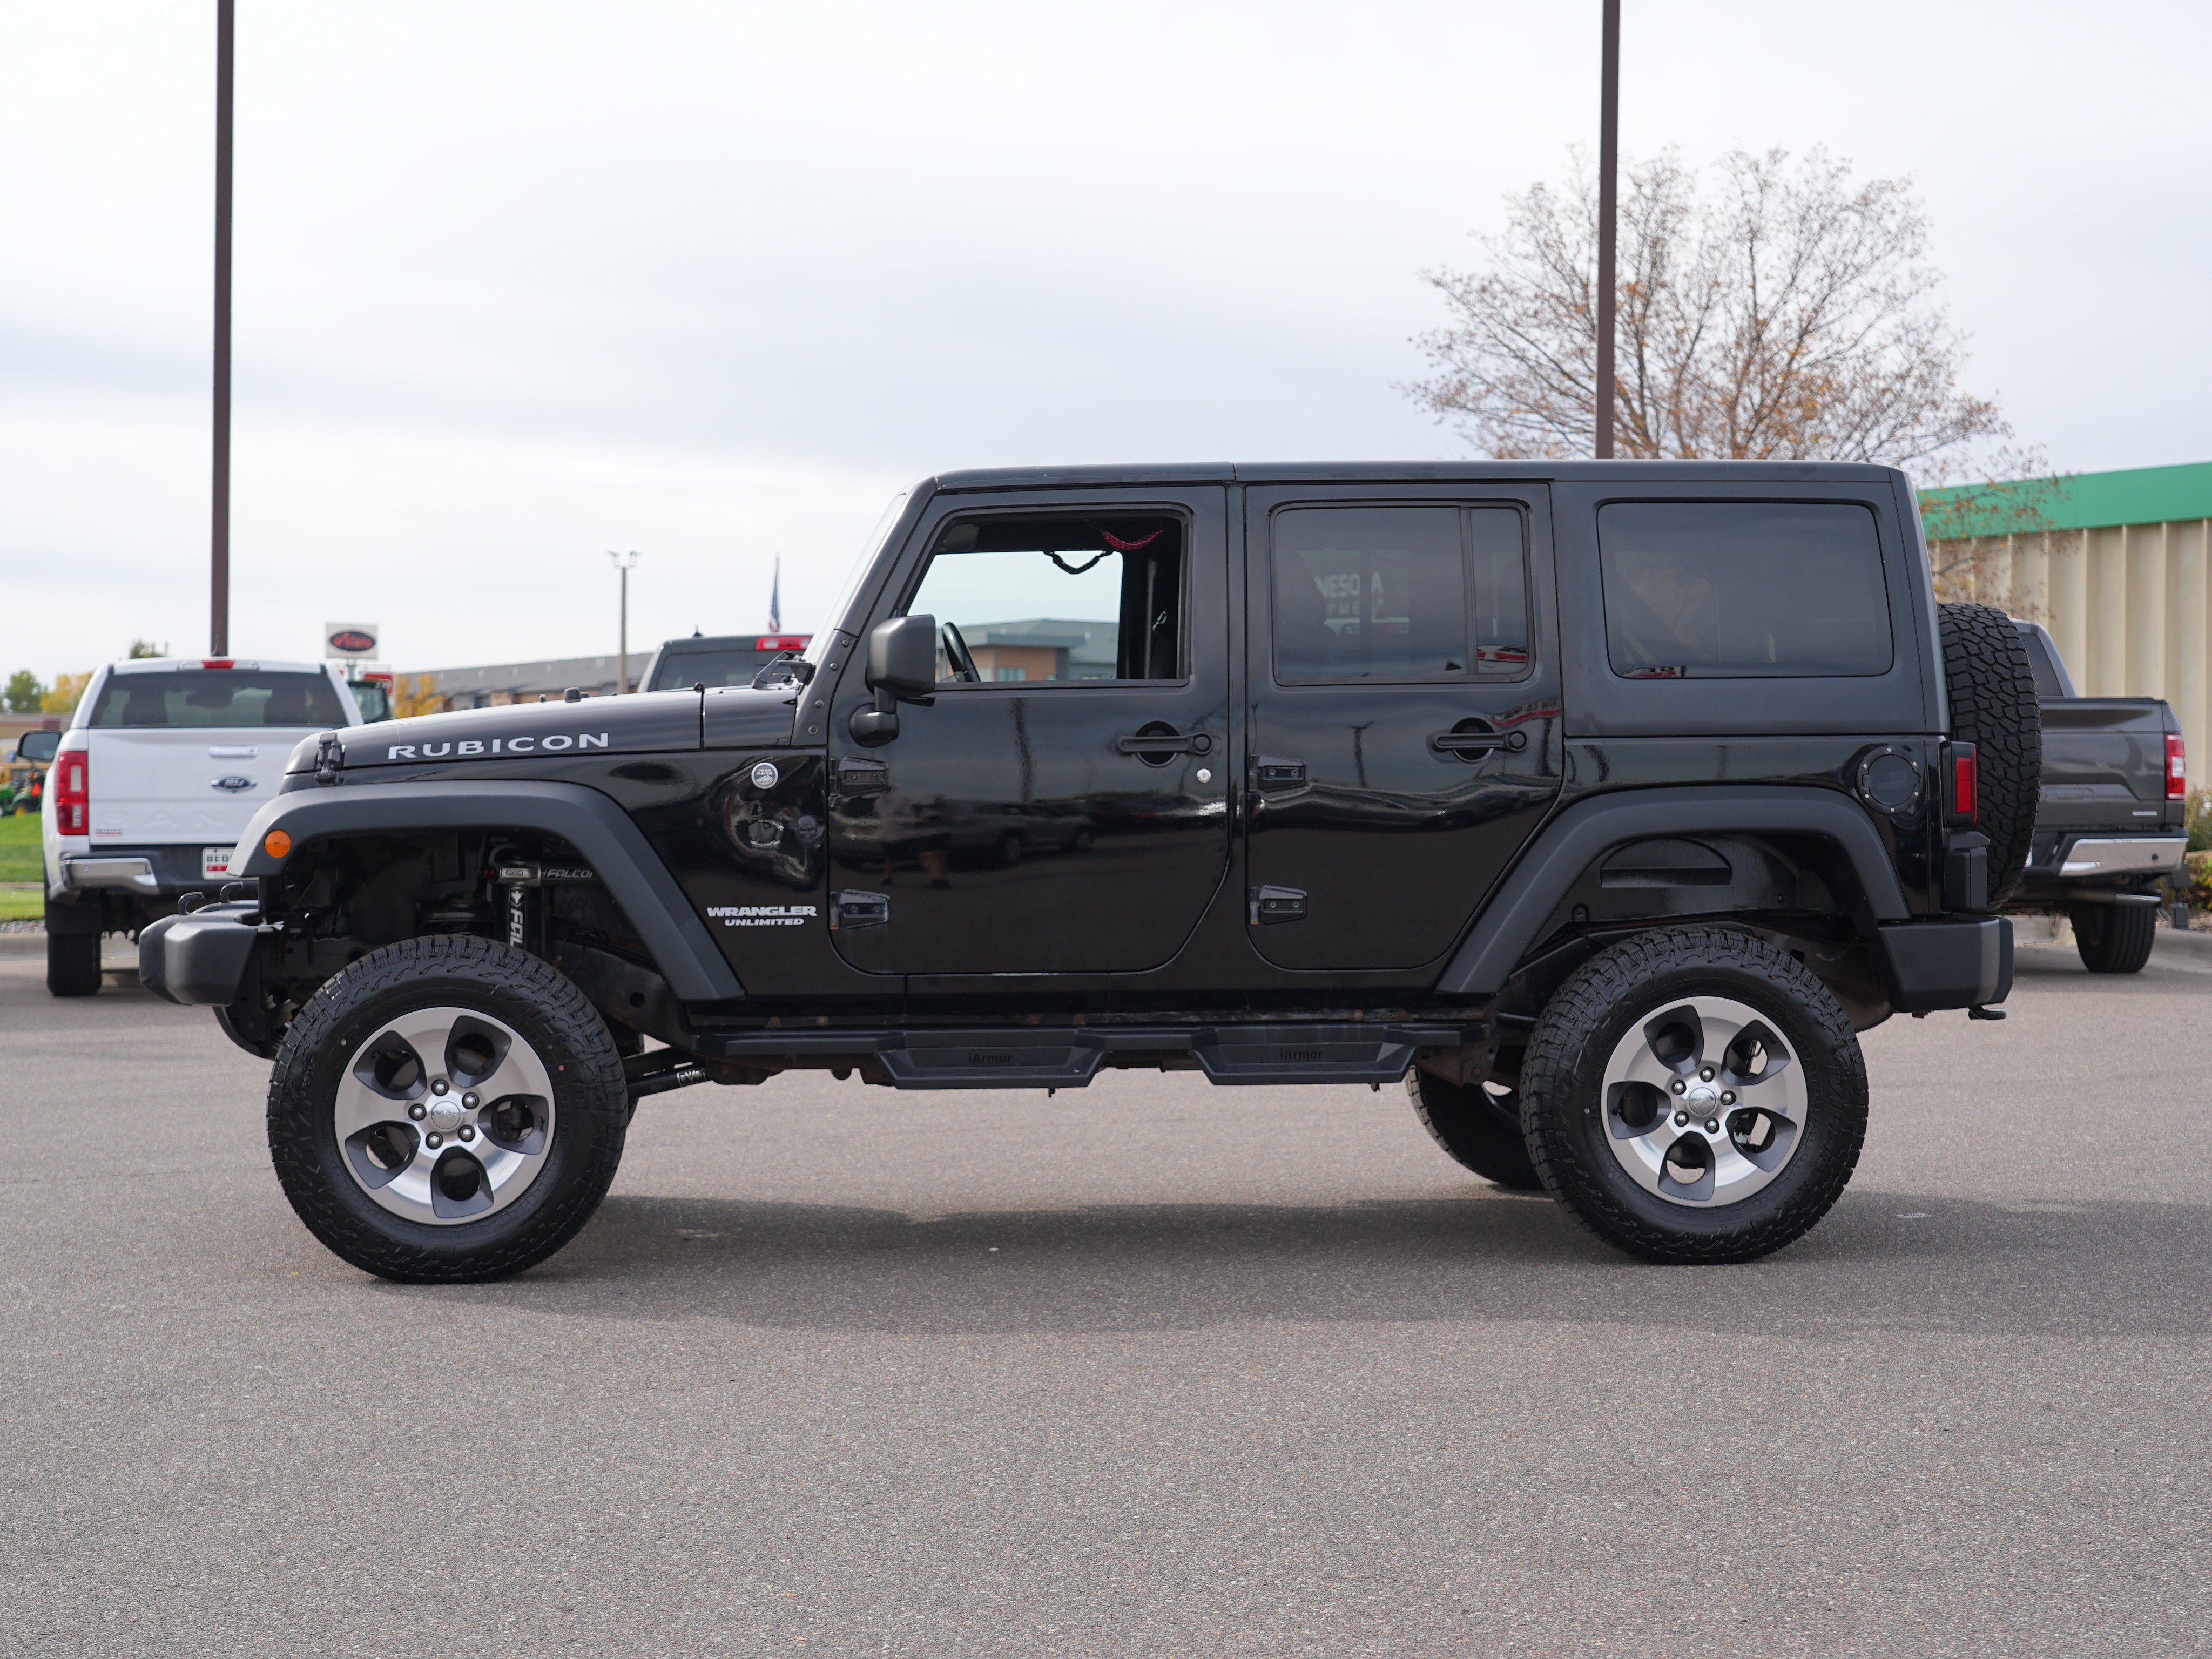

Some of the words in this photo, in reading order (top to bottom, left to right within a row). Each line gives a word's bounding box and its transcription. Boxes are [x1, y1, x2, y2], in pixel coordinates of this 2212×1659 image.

[388, 732, 609, 760] RUBICON
[206, 854, 232, 862] BED
[706, 906, 818, 918] WRANGLER
[510, 907, 524, 946] FAL
[724, 918, 805, 927] UNLIMITED
[968, 1051, 1013, 1064] iArmor
[1280, 1048, 1324, 1060] iArmor
